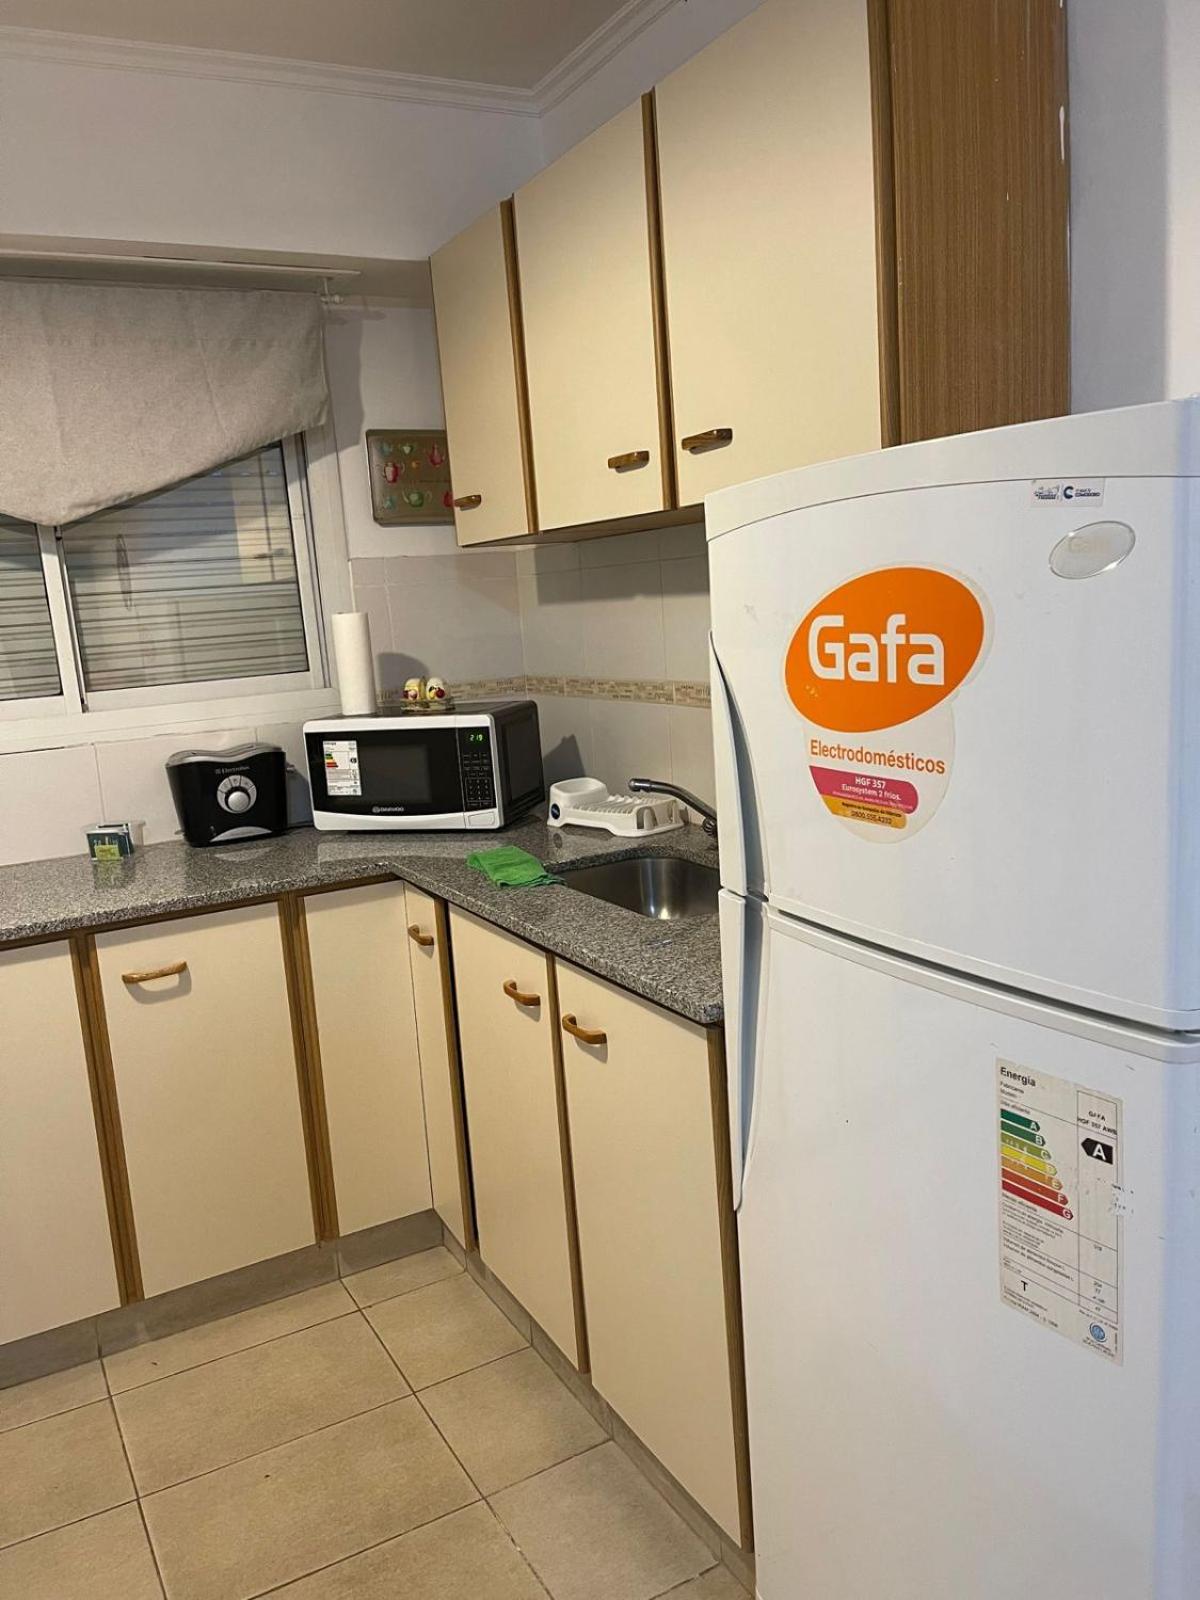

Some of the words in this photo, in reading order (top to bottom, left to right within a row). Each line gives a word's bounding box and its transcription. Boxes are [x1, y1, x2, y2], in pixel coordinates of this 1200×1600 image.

[808, 613, 945, 686] Gafa
[810, 739, 946, 774] Electrodomésticos
[855, 776, 871, 786] HGF
[872, 779, 887, 789] 357
[1030, 1121, 1038, 1131] A
[1035, 1135, 1042, 1146] B
[1092, 1143, 1107, 1161] A
[1062, 1207, 1071, 1219] G
[1020, 1280, 1028, 1292] T
